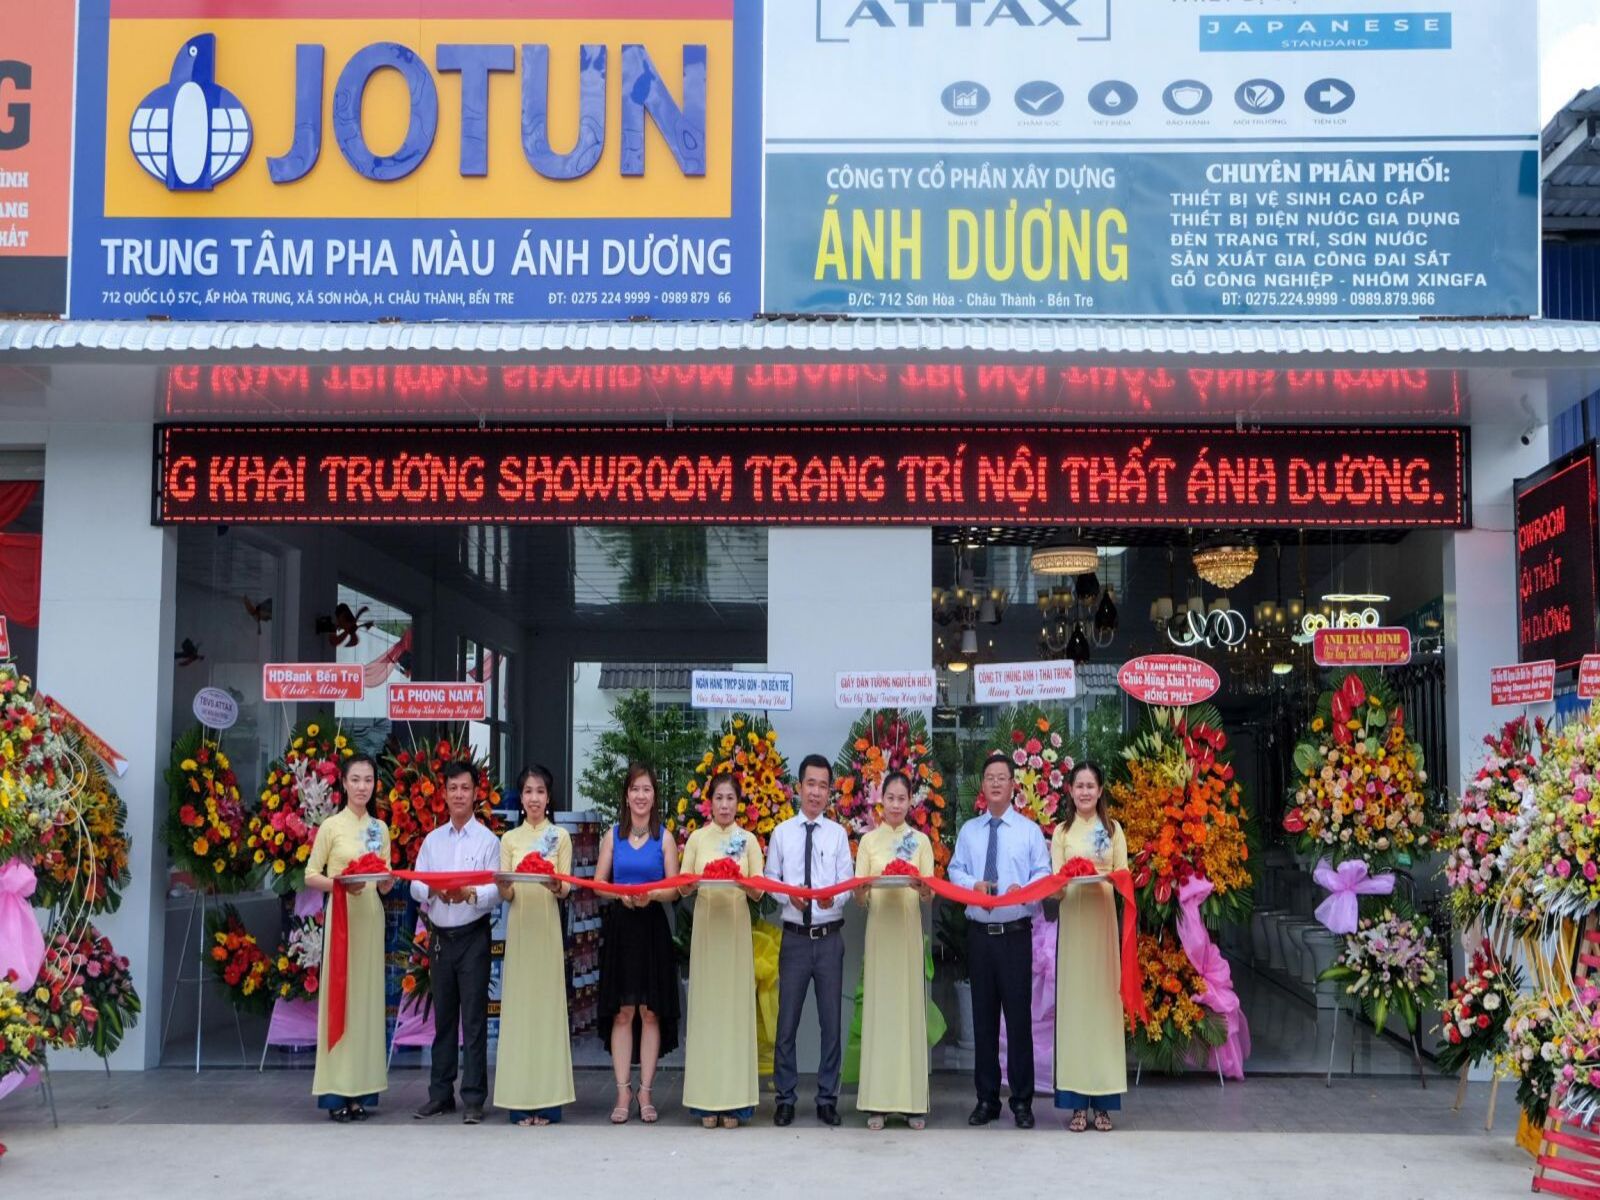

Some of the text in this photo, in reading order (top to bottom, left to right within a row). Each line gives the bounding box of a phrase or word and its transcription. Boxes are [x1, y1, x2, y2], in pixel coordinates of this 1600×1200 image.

[845, 0, 1081, 27] ATTAX
[1207, 19, 1439, 34] JAPANESE
[1281, 38, 1368, 48] STANDARD
[266, 41, 707, 183] JOTUN
[827, 161, 1116, 194] CÔNG TY CỔ PHẦN XÂY DỰNG
[1206, 156, 1450, 183] CHUYÊN PHÂN PHỐI:
[1170, 189, 1425, 208] THIẾT BỊ VỆ SINH CAO CẤP
[1170, 209, 1460, 228] THIẾT BỊ ĐIỆN NƯỚC GIA DỤNG
[814, 194, 1128, 281] ÁNH DƯƠNG
[1171, 230, 1428, 248] ĐÈN TRANG TRÍ, SƠN NƯỚC
[101, 229, 731, 276] TRUNG TÂM PHA MÀU ÁNH DƯƠNG
[1171, 249, 1208, 267] SẢN
[1217, 249, 1267, 267] XUẤT
[1274, 253, 1306, 266] GIA
[1314, 251, 1366, 266] CÔNG
[1375, 253, 1406, 266] ĐAI
[1171, 269, 1487, 289] GỖ CÔNG NGHIỆP NHÔM XINGFA
[102, 288, 514, 307] 712 QUỐC LỘ 57C, ẤP HÒA TRUNG, XÃ SƠN HÒA, H. CHÂU THÀNH, BẾN TRE
[548, 291, 731, 304] ĐT: 0275 224 9999 0989 879 66
[849, 292, 1094, 308] Đ/C: 712 Sơn Hòa Châu Thành Bến Tre
[1222, 291, 1435, 306] ĐT: 0275.224.9999 0989.879.966
[169, 437, 1445, 513] G KHAI TRƯƠNG SHOWROOM TRANG TRÍ NỘI THẤT ÁNH DƯƠNG.
[1324, 633, 1343, 644] ANH
[1375, 631, 1401, 644] BÌNH
[268, 667, 360, 683] HDBank Bến Tre
[1150, 662, 1168, 672] XANH
[280, 682, 310, 695] Chúc
[696, 675, 709, 689] NGÂN
[710, 675, 723, 690] HÀNG
[724, 678, 737, 690] TMCP
[1123, 672, 1143, 685] Chúc
[1143, 673, 1165, 688] Mừng
[1167, 673, 1184, 687] Khai
[408, 688, 445, 702] PHONG
[449, 689, 473, 702] NAM
